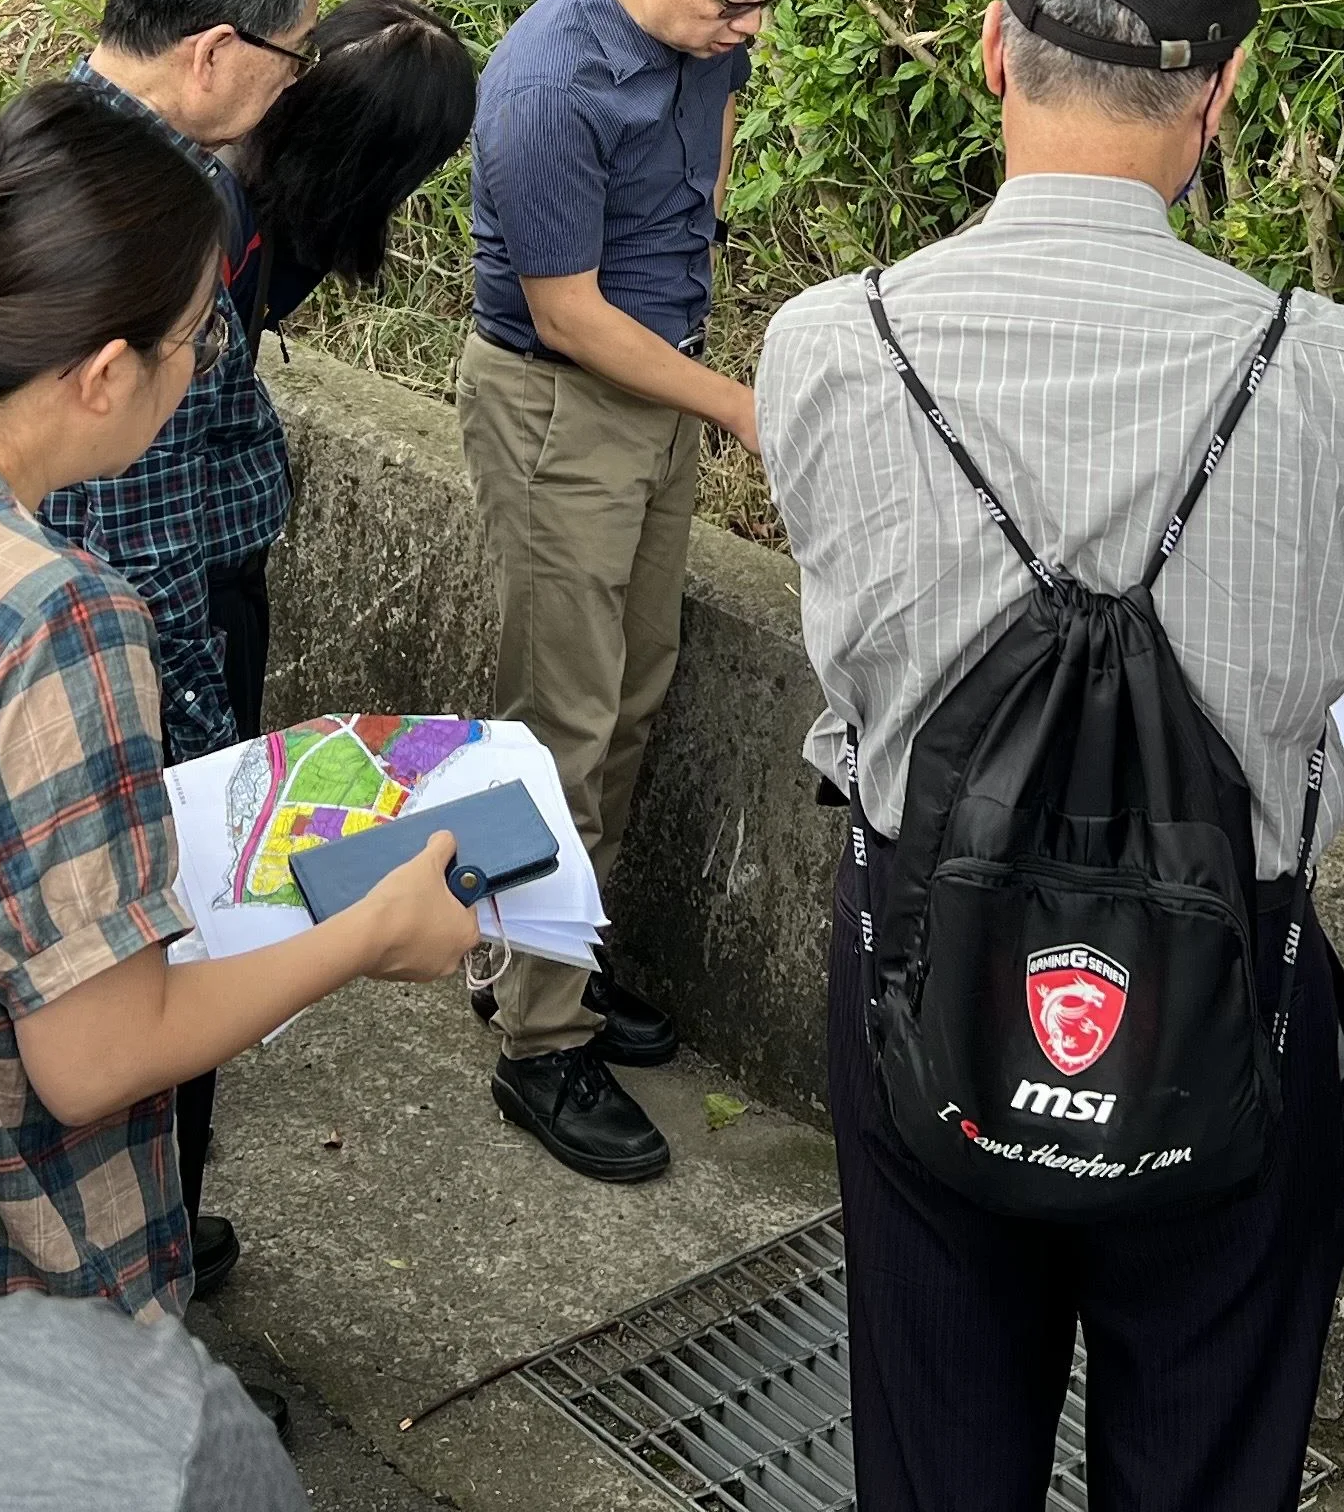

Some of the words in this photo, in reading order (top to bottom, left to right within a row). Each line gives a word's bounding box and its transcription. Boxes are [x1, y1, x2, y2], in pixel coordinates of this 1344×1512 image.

[1246, 354, 1268, 396] msi
[1204, 433, 1226, 476] msi
[1160, 515, 1183, 557] msi
[846, 744, 859, 783] msi
[1308, 749, 1325, 791] msi
[852, 826, 868, 866] msi
[861, 911, 874, 952] msi
[1283, 922, 1302, 965] msi
[1070, 949, 1089, 969] G
[1087, 956, 1126, 987] SERIES
[1010, 1079, 1117, 1124] msi
[937, 1101, 962, 1122] I
[1027, 1144, 1126, 1178] therefore
[1128, 1151, 1156, 1177] I
[1151, 1146, 1193, 1170] am
